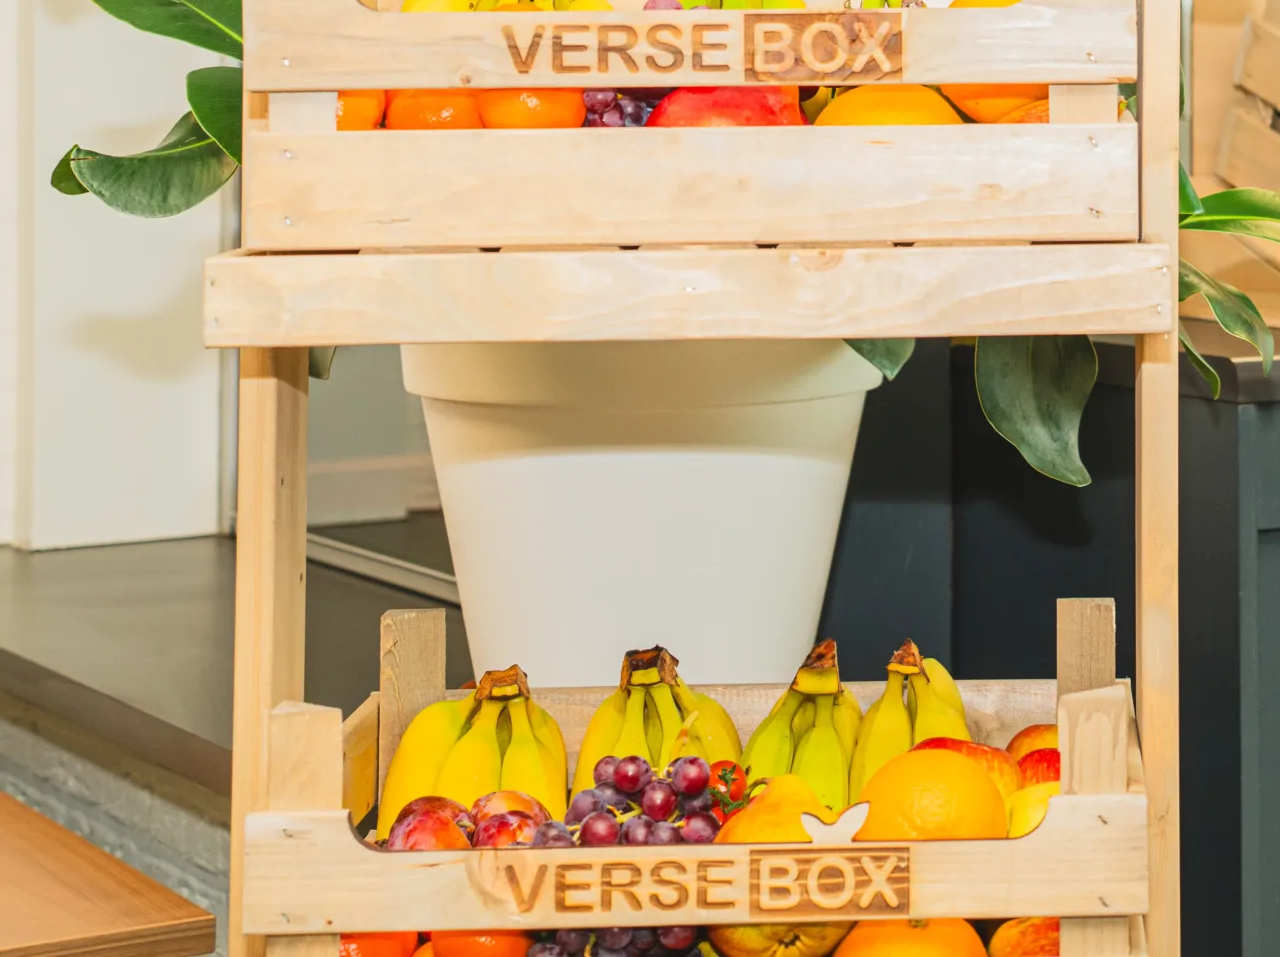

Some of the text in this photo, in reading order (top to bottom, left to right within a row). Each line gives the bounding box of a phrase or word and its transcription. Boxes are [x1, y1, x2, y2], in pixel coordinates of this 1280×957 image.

[501, 20, 893, 74] VERSE BOX
[504, 854, 902, 914] VERSE BOX
